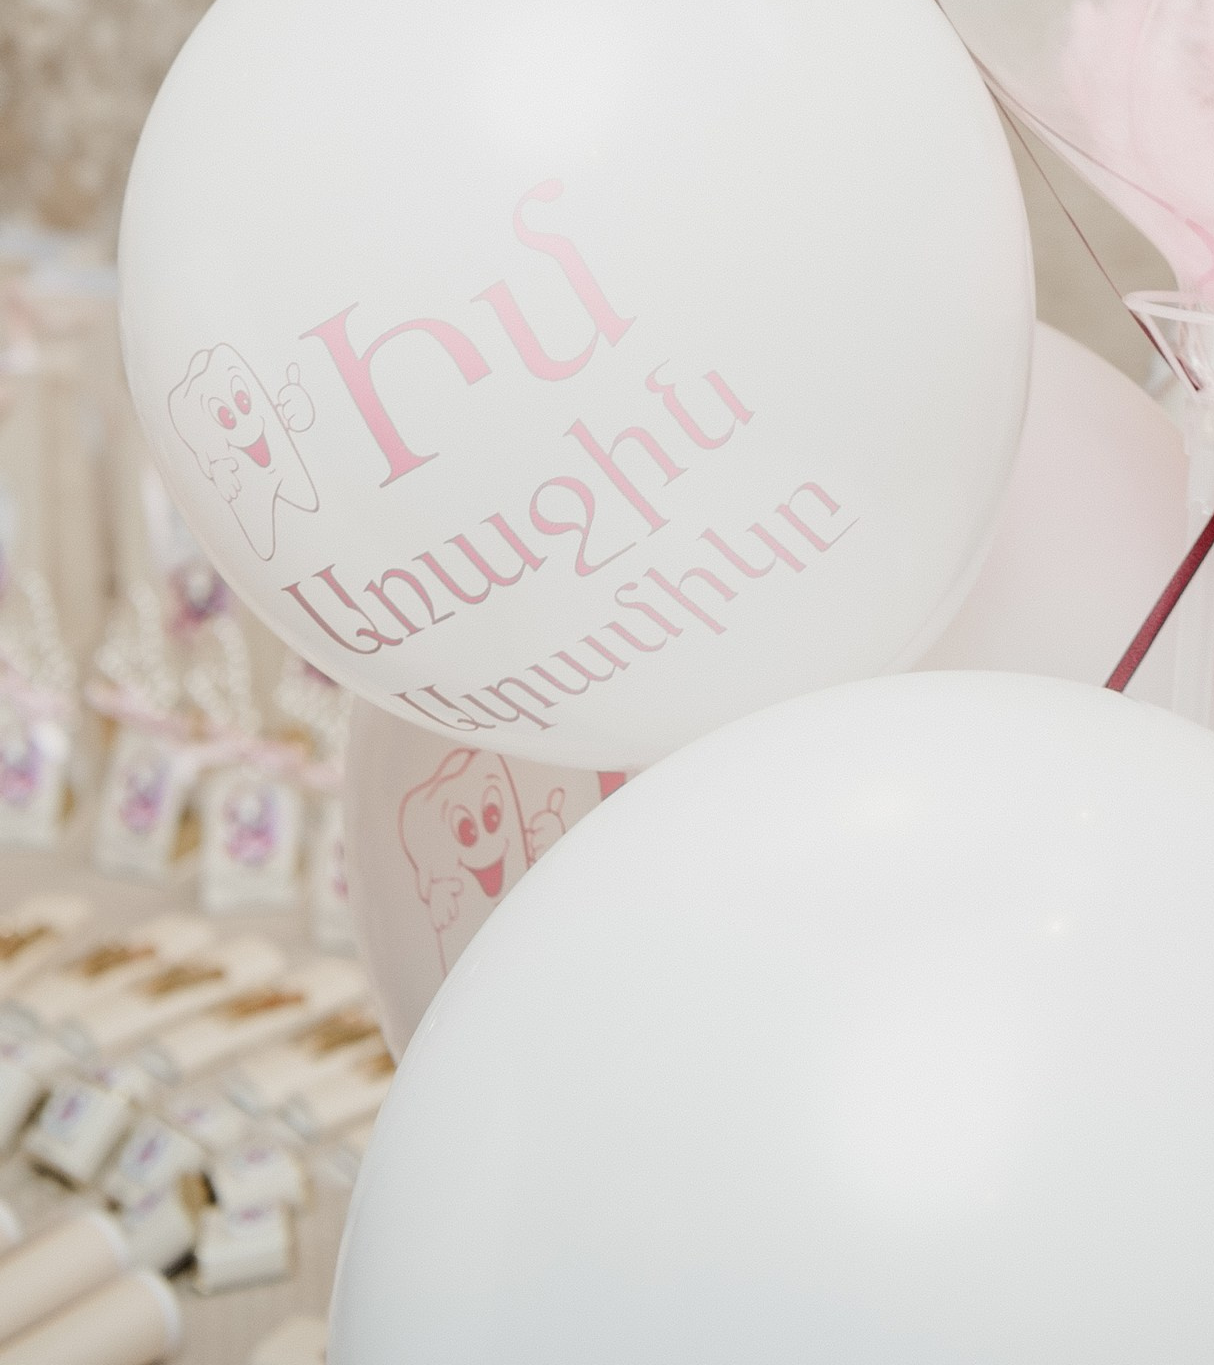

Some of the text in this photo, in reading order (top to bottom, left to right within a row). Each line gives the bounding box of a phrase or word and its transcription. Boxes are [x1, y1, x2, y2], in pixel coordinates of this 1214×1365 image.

[298, 176, 638, 489] Իմ
[280, 358, 756, 656] Առաջին
[390, 480, 861, 733] Ատամիկը
